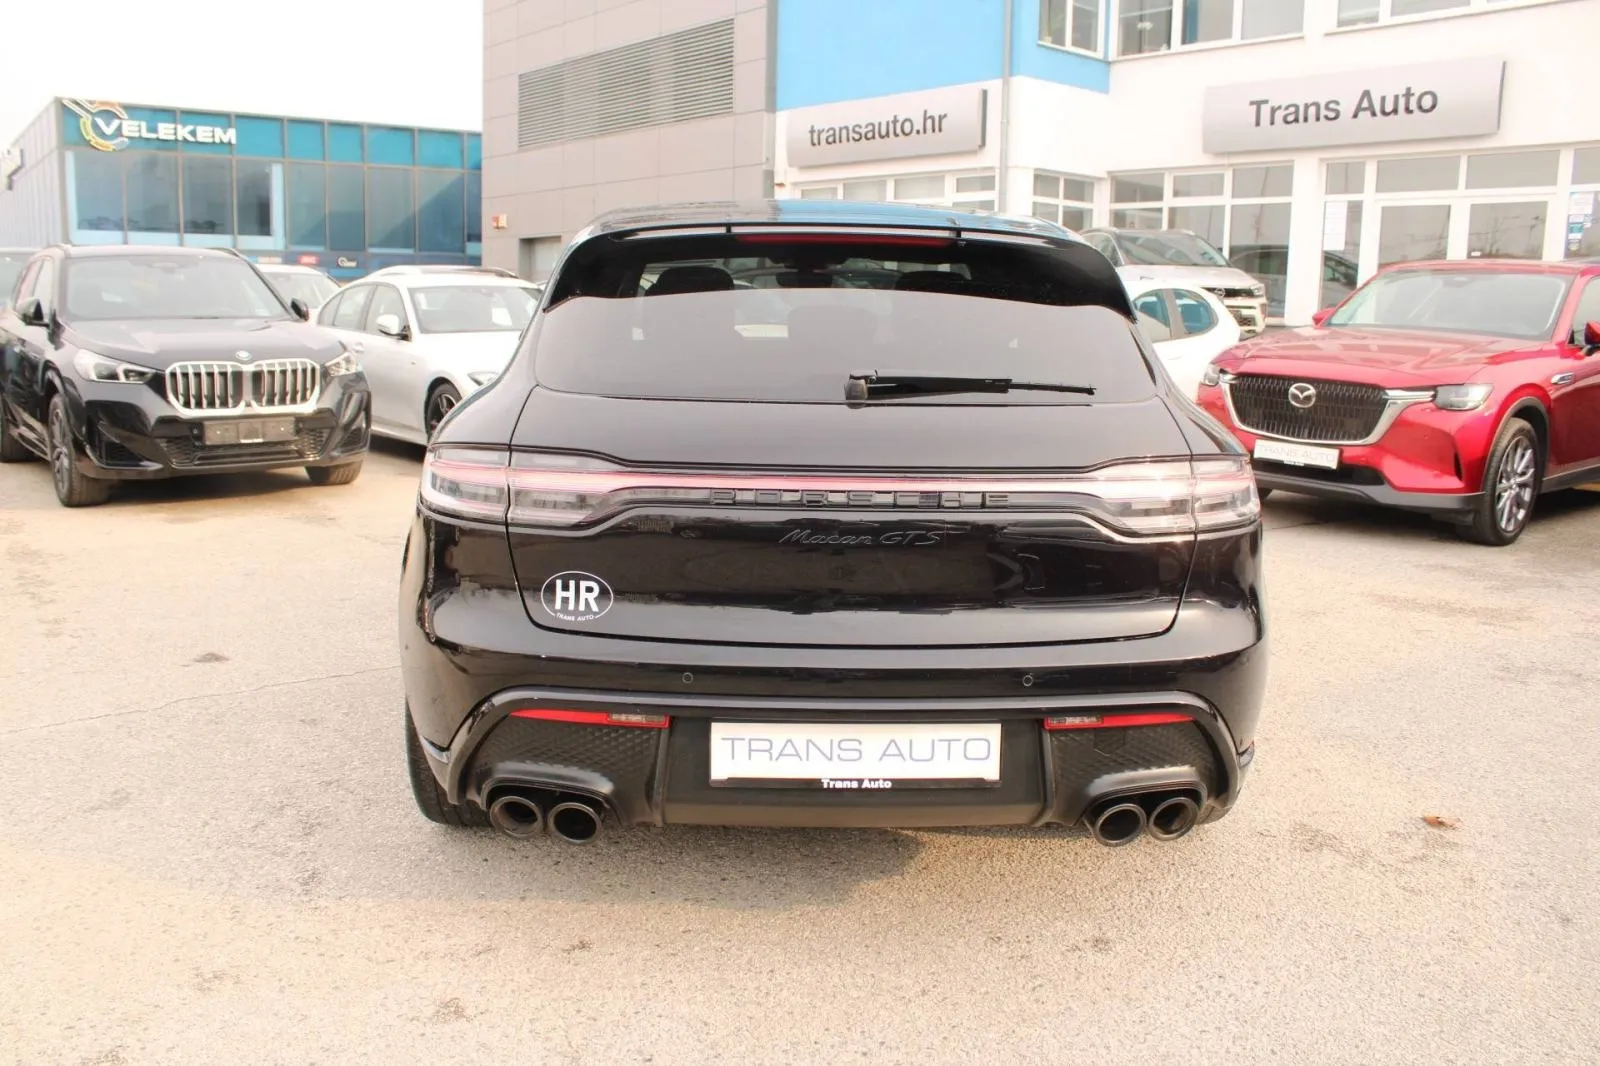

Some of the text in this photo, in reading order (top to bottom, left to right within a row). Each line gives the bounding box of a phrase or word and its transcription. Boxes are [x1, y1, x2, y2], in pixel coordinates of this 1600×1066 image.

[1249, 86, 1439, 128] Trans Auto
[94, 117, 237, 144] VELEKEM
[808, 109, 948, 147] transauto.hr
[778, 528, 942, 546] Macan GTS
[555, 579, 599, 612] HR
[720, 737, 991, 762] TRANS AUTO
[820, 778, 892, 789] Trans Auto
